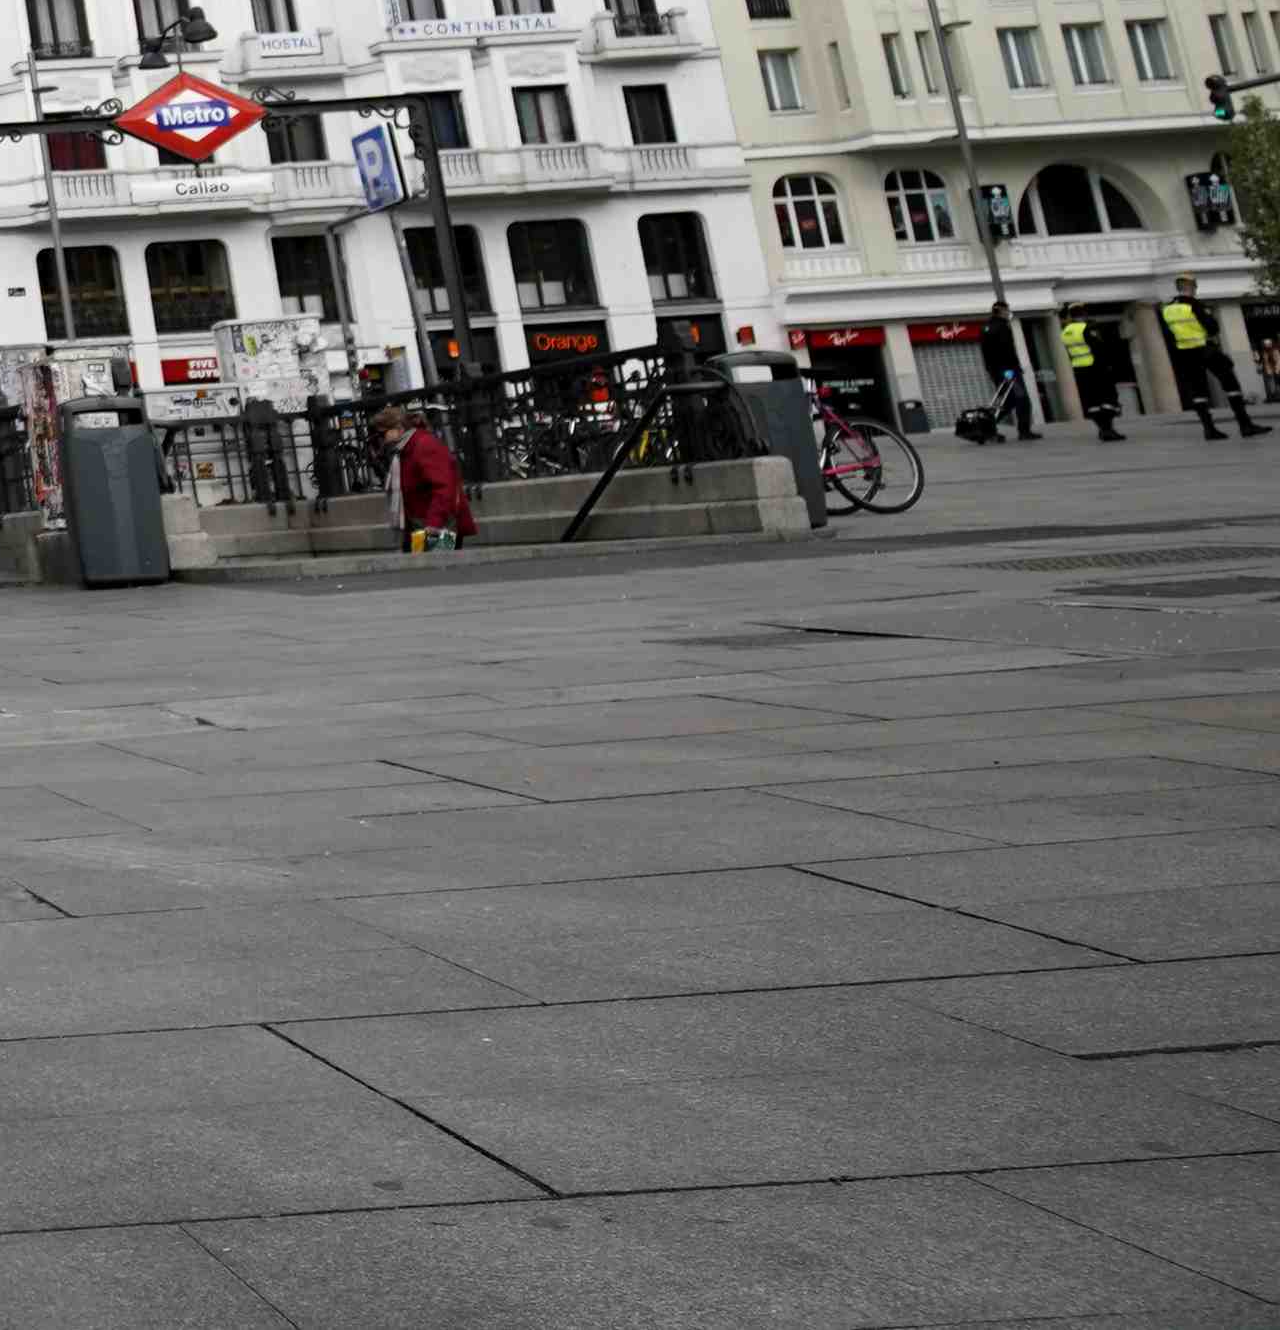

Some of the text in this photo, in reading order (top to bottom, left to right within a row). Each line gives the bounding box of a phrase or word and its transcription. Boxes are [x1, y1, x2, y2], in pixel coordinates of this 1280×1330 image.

[423, 17, 557, 36] CONTINENTAL
[261, 37, 317, 51] HOSTAL
[161, 106, 225, 126] Metro
[176, 182, 230, 196] Callao
[536, 333, 598, 352] Orange
[189, 360, 217, 369] FIVE
